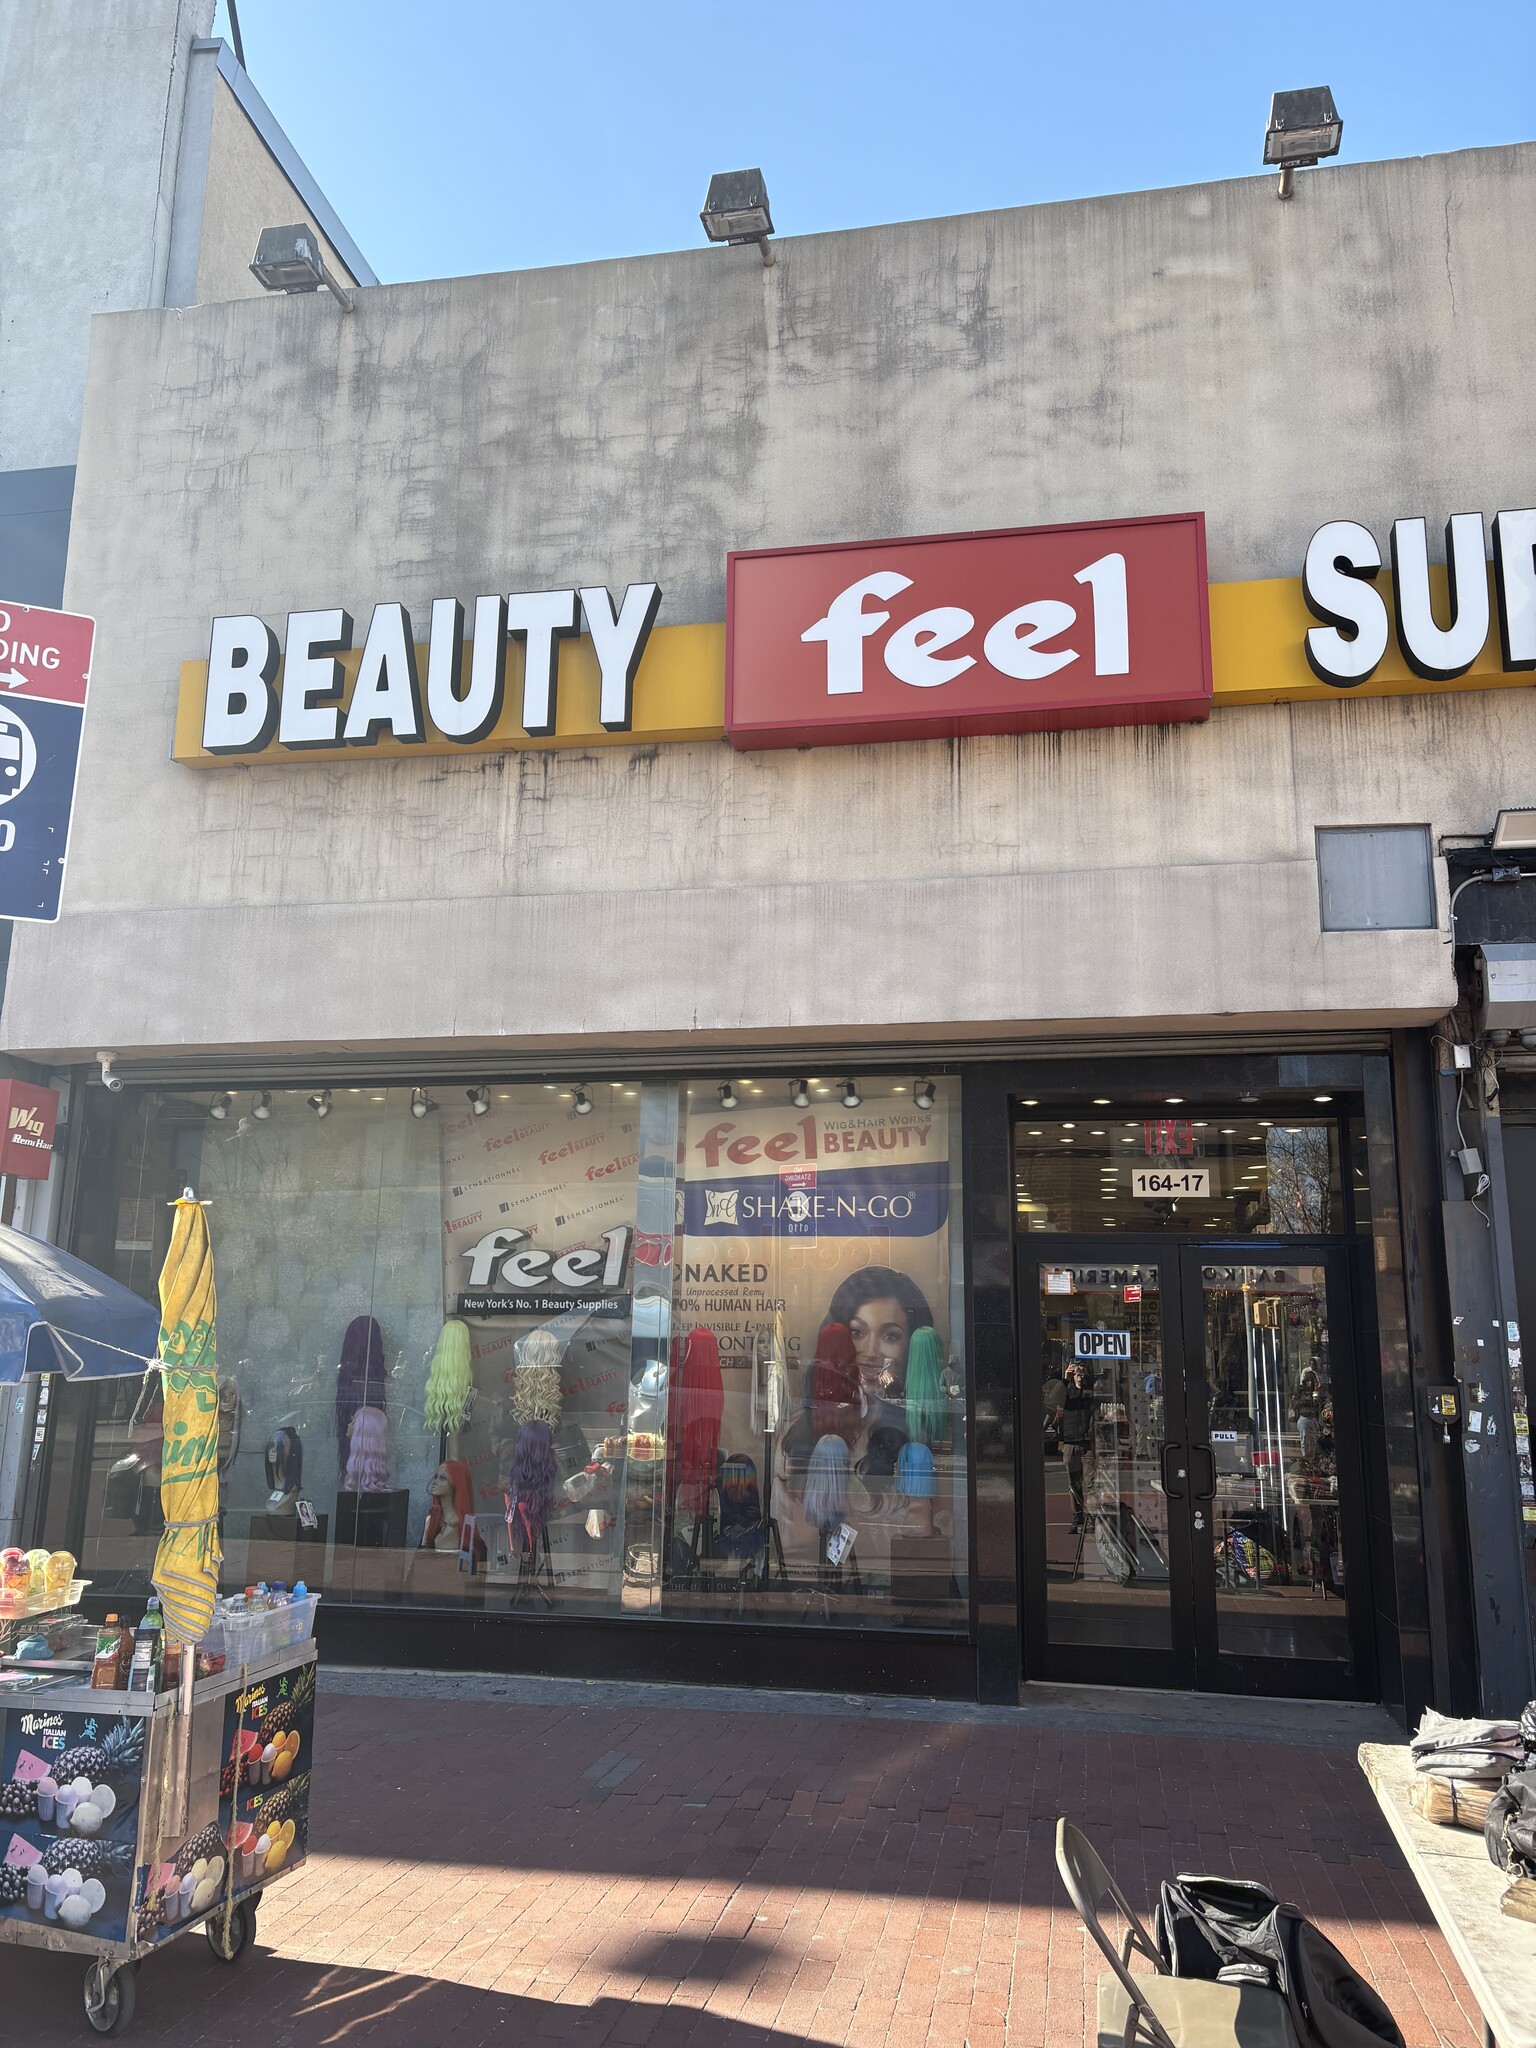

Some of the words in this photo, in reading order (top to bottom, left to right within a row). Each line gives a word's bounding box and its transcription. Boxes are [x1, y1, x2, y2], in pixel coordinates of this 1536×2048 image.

[800, 553, 1129, 694] feel
[202, 582, 662, 754] BEAUTY
[8, 1107, 45, 1137] Wig
[11, 1133, 35, 1147] Remi
[35, 1138, 53, 1150] Hair
[483, 1128, 520, 1152] feel
[519, 1121, 550, 1139] BEAUTY
[695, 1115, 817, 1168] feel
[823, 1125, 932, 1153] BEAUTY
[538, 1141, 575, 1165] feel
[574, 1134, 605, 1151] BEAUTY
[585, 1157, 622, 1181] feel
[1138, 1174, 1203, 1191] 164-17
[510, 1181, 568, 1208] SENSATIONNEL
[566, 1195, 624, 1221] SENSATIONNEL
[452, 1214, 482, 1231] BEAUTY
[460, 1225, 634, 1288] feel
[685, 1264, 768, 1282] NAKED
[686, 1287, 738, 1297] Unprocessed
[743, 1287, 765, 1298] Remy
[464, 1299, 485, 1309] New
[487, 1299, 514, 1309] York's
[516, 1299, 532, 1309] No.
[534, 1299, 539, 1309] 1
[542, 1299, 575, 1311] Beauty
[576, 1299, 618, 1311] Supplies
[704, 1299, 751, 1312] HUMAN
[481, 1338, 512, 1355] BEAUTY
[1078, 1332, 1127, 1355] OPEN
[586, 1371, 618, 1387] BEAUTY
[252, 1704, 268, 1720] ICES
[43, 1728, 66, 1737] ITALIAN
[42, 1736, 65, 1750] ICES
[246, 1793, 263, 1811] ICES
